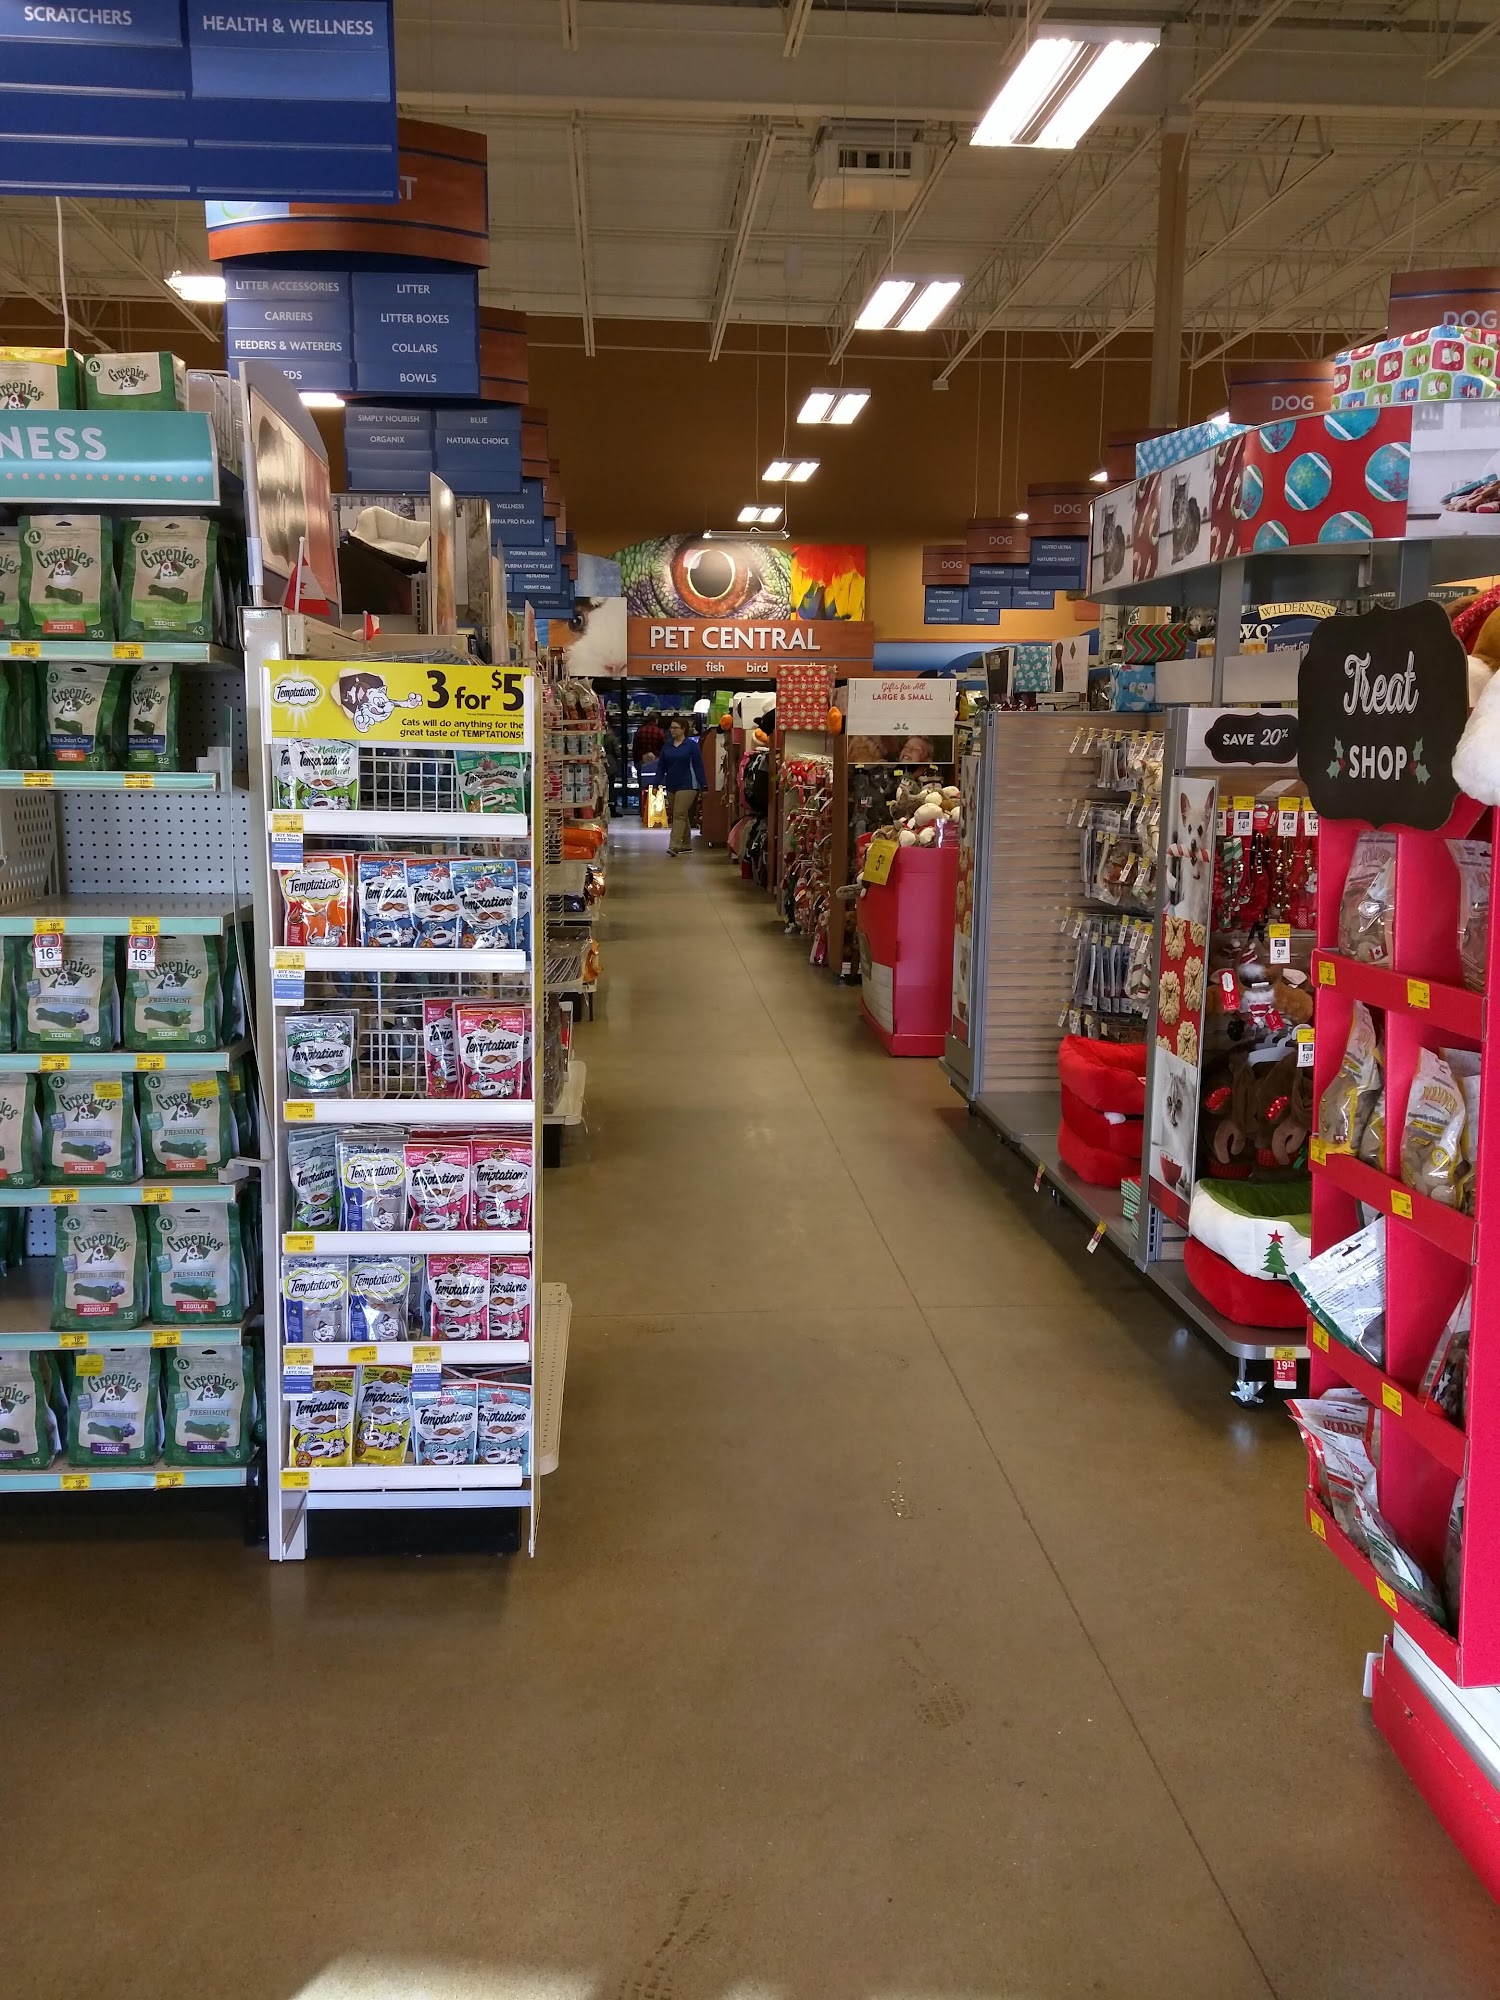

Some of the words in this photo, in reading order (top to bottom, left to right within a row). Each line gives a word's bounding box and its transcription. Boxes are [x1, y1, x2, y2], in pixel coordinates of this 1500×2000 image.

[24, 6, 133, 26] SCRATCHERS
[202, 15, 268, 33] HEALTH
[273, 18, 285, 34] &
[288, 18, 374, 36] WELLNESS
[235, 281, 269, 291] LITTER
[272, 281, 340, 292] ACCESSORIES
[396, 284, 431, 295] LITTER
[264, 311, 313, 322] CARRIERS
[380, 313, 414, 323] LITTER
[416, 314, 450, 324] BOXES
[1443, 310, 1498, 329] DOG
[235, 340, 277, 350] FEEDERS
[279, 341, 287, 351] &
[290, 341, 343, 352] WATERERS
[391, 343, 438, 354] COLLARS
[108, 365, 149, 382] Greenies
[283, 371, 303, 381] EDS
[400, 373, 437, 383] BOWLS
[0, 380, 44, 402] reenies
[1271, 395, 1315, 412] DOG
[357, 414, 384, 423] SIMPLY
[385, 415, 420, 424] NOURISH
[470, 416, 488, 425] BLUE
[0, 426, 107, 461] NESS
[370, 435, 405, 444] ORGANIX
[446, 437, 480, 446] NATURAL
[481, 437, 509, 446] CHOICE
[1053, 504, 1082, 515] DOG
[989, 536, 1013, 545] DOG
[36, 545, 95, 569] Greenies
[140, 546, 200, 570] Greenies
[941, 561, 963, 569] DOG
[1448, 590, 1464, 598] Diet
[1261, 603, 1333, 617] WILDERNESS
[92, 630, 105, 639] 20
[192, 626, 206, 636] 43
[650, 626, 695, 648] PET
[701, 627, 821, 650] CENTRAL
[651, 661, 688, 673] reptile
[705, 661, 725, 673] fish
[746, 662, 769, 673] bird
[881, 682, 899, 693] Gifts
[899, 683, 911, 692] for
[1343, 651, 1420, 716] Treat
[277, 685, 317, 701] Temptations
[426, 671, 449, 709] 3
[455, 686, 491, 710] for
[491, 670, 524, 711] $5
[51, 687, 97, 707] Greenies
[401, 718, 420, 727] Cats
[422, 719, 438, 727] will
[440, 719, 452, 728] do
[454, 720, 493, 730] anything
[495, 720, 508, 729] for
[510, 720, 524, 729] the
[400, 729, 424, 738] great
[426, 729, 448, 738] taste
[450, 729, 460, 738] of
[461, 730, 524, 739] TEMPTATIONS!
[1222, 733, 1255, 746] SAVE
[1260, 728, 1289, 746] 20%
[157, 757, 170, 765] 22
[300, 750, 350, 770] Temptatis
[1349, 744, 1408, 780] SHOP
[289, 878, 341, 894] Temptations
[460, 891, 514, 910] Temptations
[89, 1036, 101, 1046] 43
[195, 1034, 207, 1045] 43
[466, 1036, 518, 1056] Temptations
[164, 1128, 205, 1136] FRESHMINT
[111, 1170, 123, 1179] 20
[412, 1169, 465, 1189] Temptations
[12, 1177, 24, 1186] 30
[73, 1232, 131, 1254] Greenies
[167, 1232, 224, 1253] Greenies
[173, 1270, 216, 1278] FRESHMINT
[291, 1278, 340, 1294] Temptations
[354, 1273, 402, 1289] Temptations
[434, 1279, 485, 1296] Temptations
[490, 1281, 528, 1294] ptations
[123, 1311, 134, 1320] 12
[221, 1309, 232, 1318] 12
[88, 1372, 142, 1394] Greenies
[184, 1372, 239, 1393] Greenies
[189, 1409, 230, 1417] FRESHMINT
[296, 1400, 350, 1418] Temptations
[420, 1409, 473, 1429] Temptations
[139, 1450, 146, 1459] 8
[235, 1450, 241, 1459] 8
[30, 1457, 41, 1465] 12
